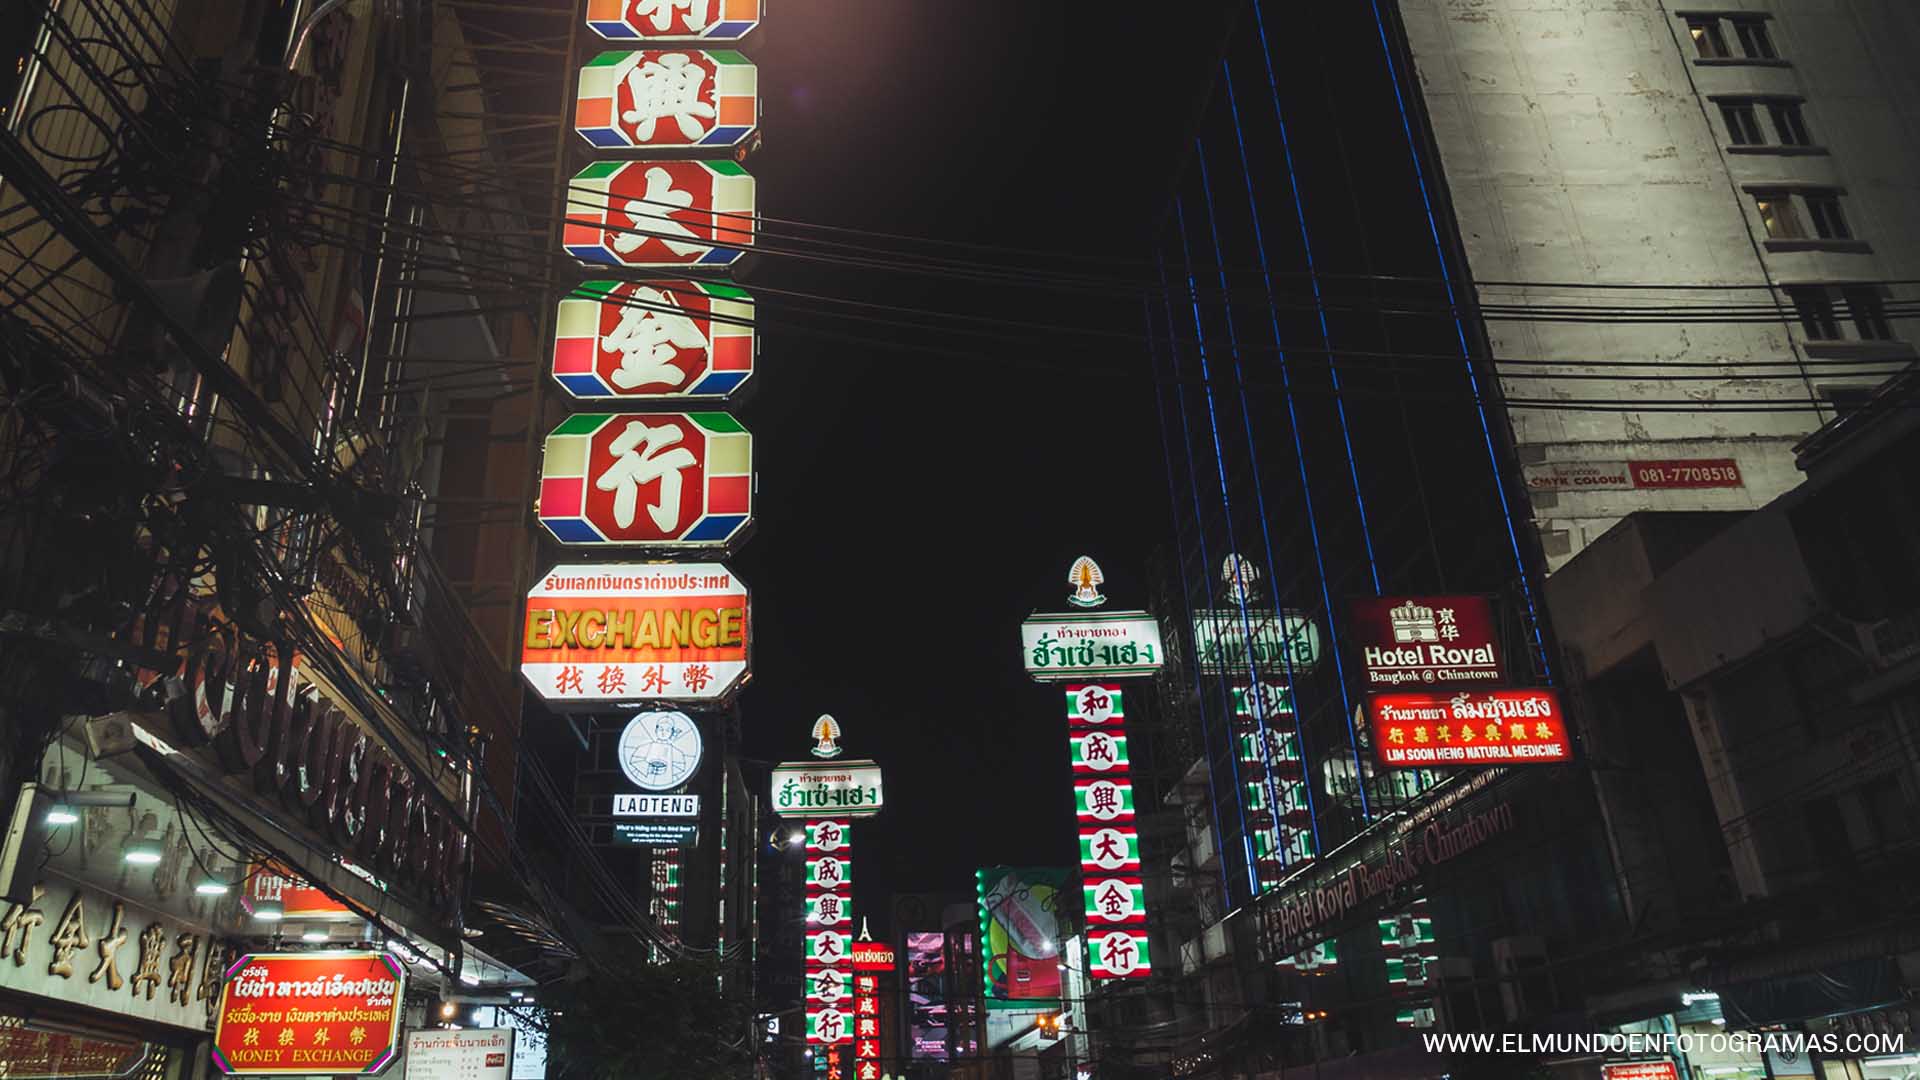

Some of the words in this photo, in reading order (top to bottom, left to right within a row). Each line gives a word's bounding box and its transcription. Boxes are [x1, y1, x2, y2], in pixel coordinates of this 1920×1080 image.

[1574, 474, 1627, 486] COLOUR
[1639, 467, 1738, 483] 081-7708518
[544, 573, 730, 591] รับแลกเงินตราต่างประเทศ
[526, 607, 743, 650] EXCHANGE
[1056, 625, 1127, 638] ห้างขายทอง
[1436, 607, 1460, 642] 京华
[1032, 632, 1155, 667] ฮั่วเซ่งเฮง
[1364, 645, 1424, 666] Hotel
[1429, 643, 1495, 665] Royal
[1369, 669, 1420, 685] Bangkok
[1422, 669, 1436, 683] @
[1437, 668, 1499, 681] Chinatown
[1380, 704, 1447, 721] ร้านขายยา
[1386, 749, 1405, 761] LIM
[1407, 748, 1435, 761] SOON
[1437, 747, 1465, 760] HENG
[1466, 746, 1513, 759] NATURAL
[1513, 744, 1564, 758] MEDICINE
[778, 778, 877, 807] ฮั่วเซ่งเฮง
[618, 798, 693, 813] LAOTENG
[1081, 689, 1133, 969] 和成興大金行
[1278, 896, 1314, 938] Hotel
[1317, 875, 1357, 920] Royal
[1424, 800, 1514, 869] Chinatown
[815, 824, 842, 1039] 和成興大金行
[242, 966, 269, 977] บริษัท
[367, 996, 392, 1006] จำกัด
[286, 1007, 390, 1023] เงินตราต่างประเทศ
[231, 1050, 284, 1063] MONEY
[292, 1050, 373, 1063] EXCHANGE
